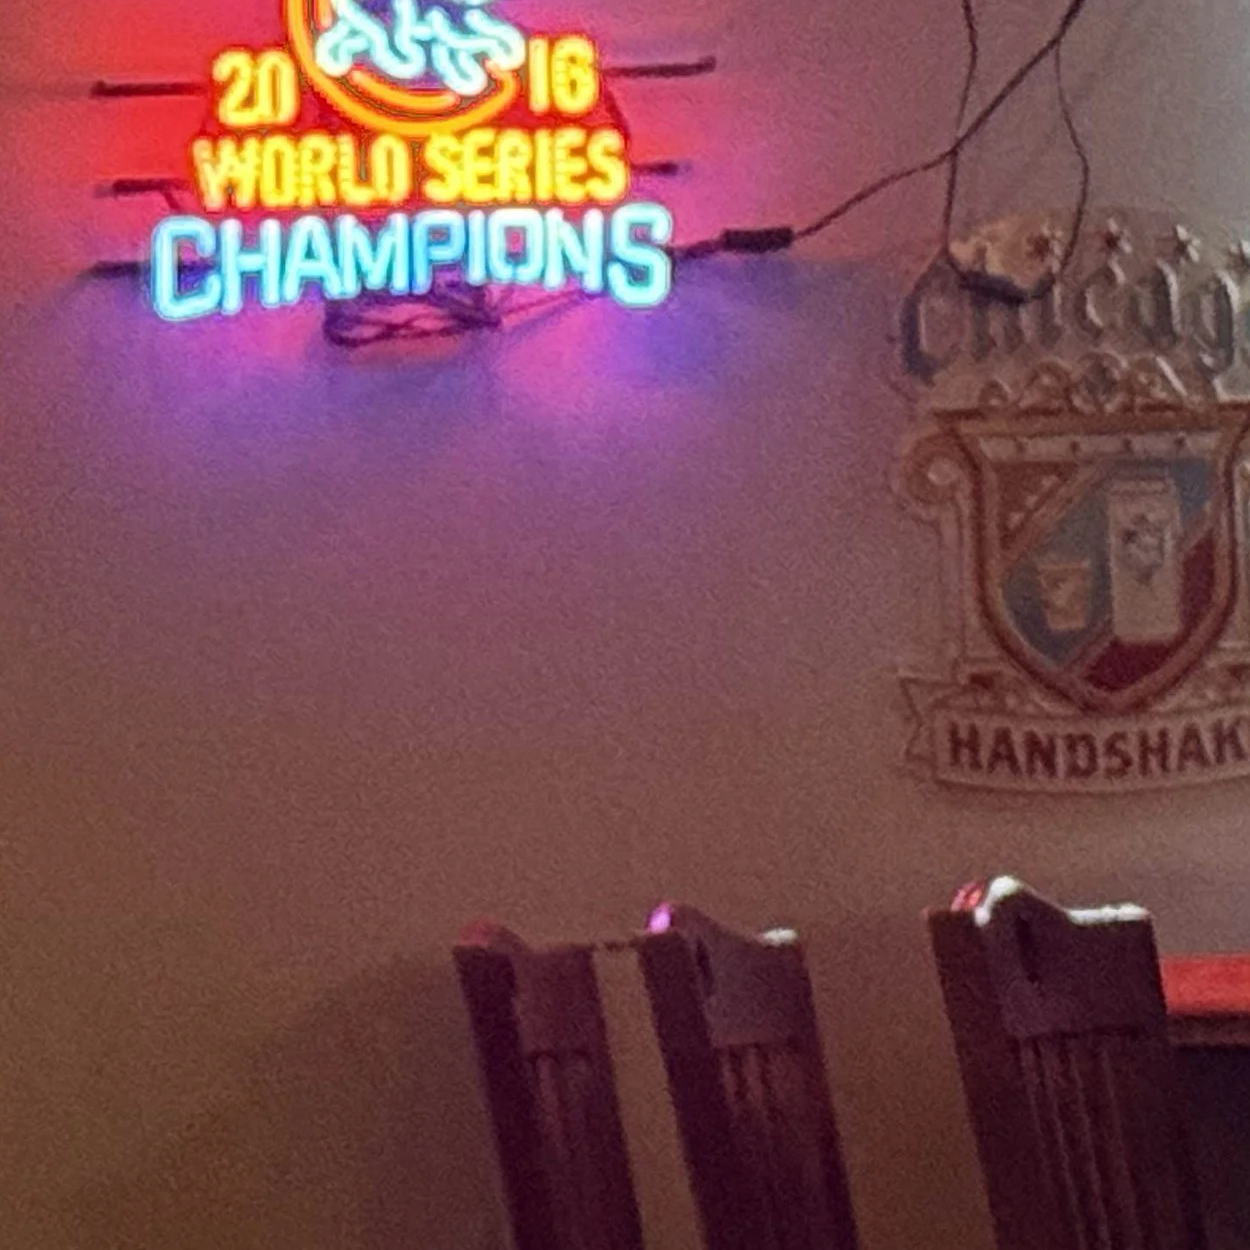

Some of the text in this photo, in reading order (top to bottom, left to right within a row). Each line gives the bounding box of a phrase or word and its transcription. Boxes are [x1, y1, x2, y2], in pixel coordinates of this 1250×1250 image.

[212, 50, 298, 126] 20
[528, 35, 599, 115] 16
[193, 128, 629, 210] WORLD SERIES
[152, 203, 674, 322] CHAMPIONS
